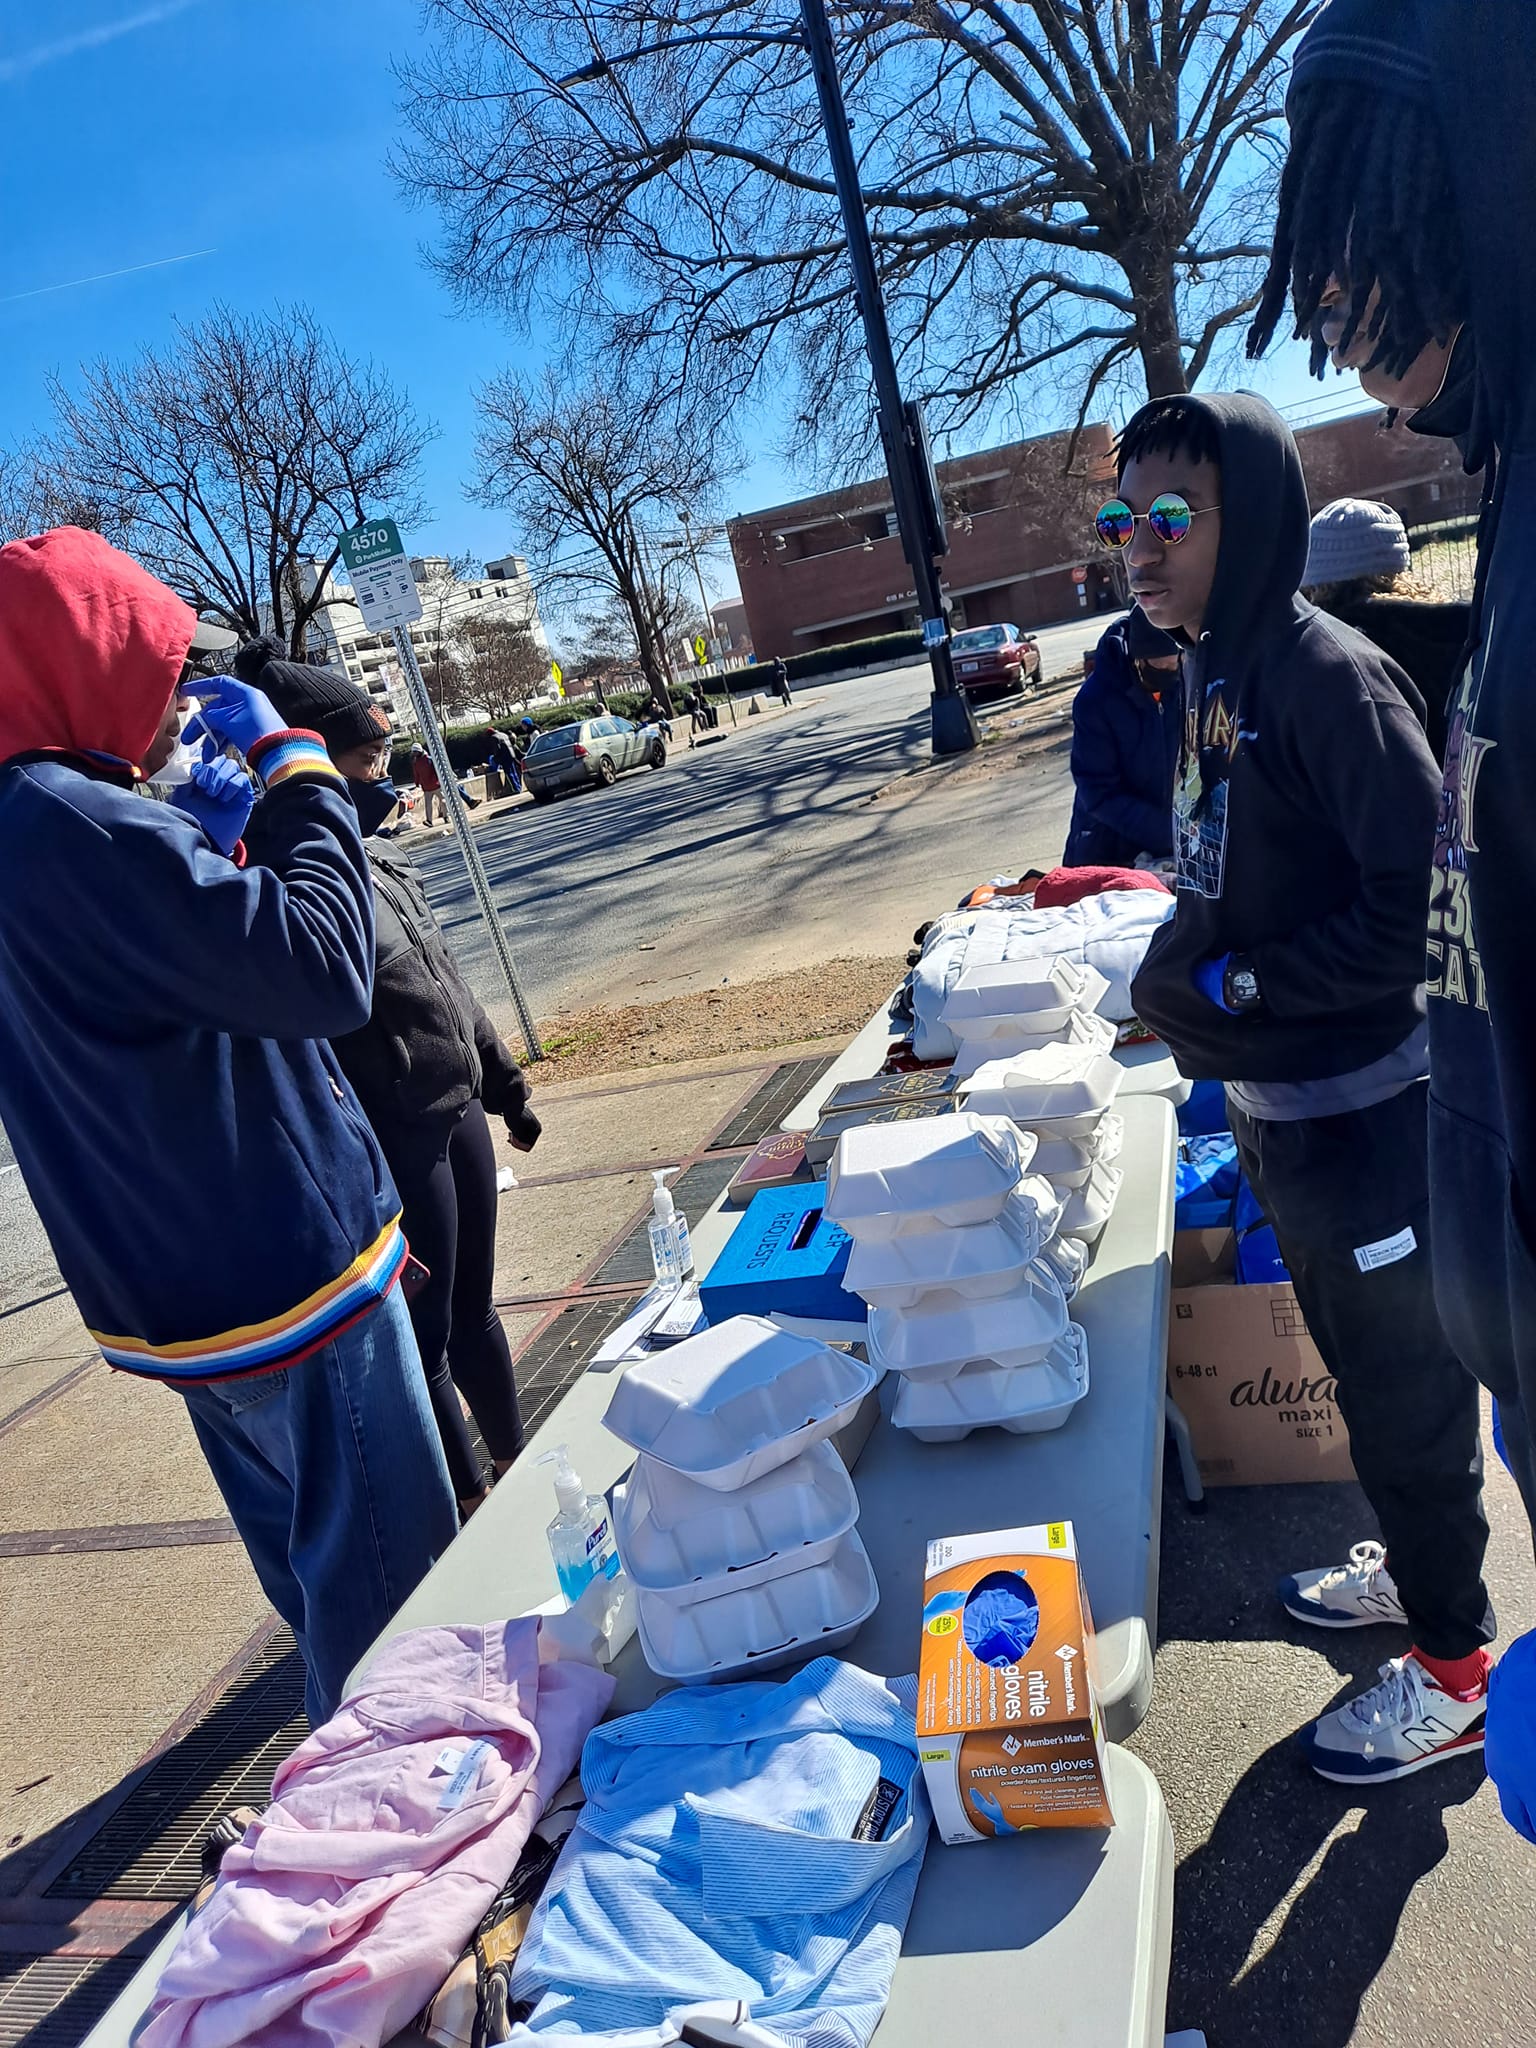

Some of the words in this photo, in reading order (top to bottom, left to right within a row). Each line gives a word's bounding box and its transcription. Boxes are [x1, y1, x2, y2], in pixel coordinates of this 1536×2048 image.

[351, 529, 388, 551] 4570
[369, 560, 392, 573] Payment
[391, 559, 403, 567] Only
[746, 1211, 795, 1270] REQUESTS
[1175, 1365, 1201, 1378] 6-48
[1204, 1365, 1218, 1377] ct
[1279, 1405, 1332, 1423] maxi
[1296, 1427, 1322, 1438] SIZE
[1326, 1424, 1333, 1437] 1
[1051, 1526, 1060, 1544] Large
[943, 1617, 952, 1631] 25%
[1063, 1661, 1073, 1694] Member's
[1000, 1665, 1026, 1720] gloves
[1028, 1669, 1051, 1717] nitrile
[989, 1691, 997, 1721] fingertips
[1066, 1694, 1077, 1712] Mark
[1023, 1735, 1063, 1748] Member's
[1064, 1733, 1086, 1743] Mark
[1401, 1715, 1458, 1754] N
[971, 1765, 1008, 1779] nitrile
[1011, 1763, 1047, 1775] exam
[1050, 1758, 1095, 1774] gloves
[1067, 1773, 1097, 1782] fingertips
[869, 1799, 890, 1826] STACY
